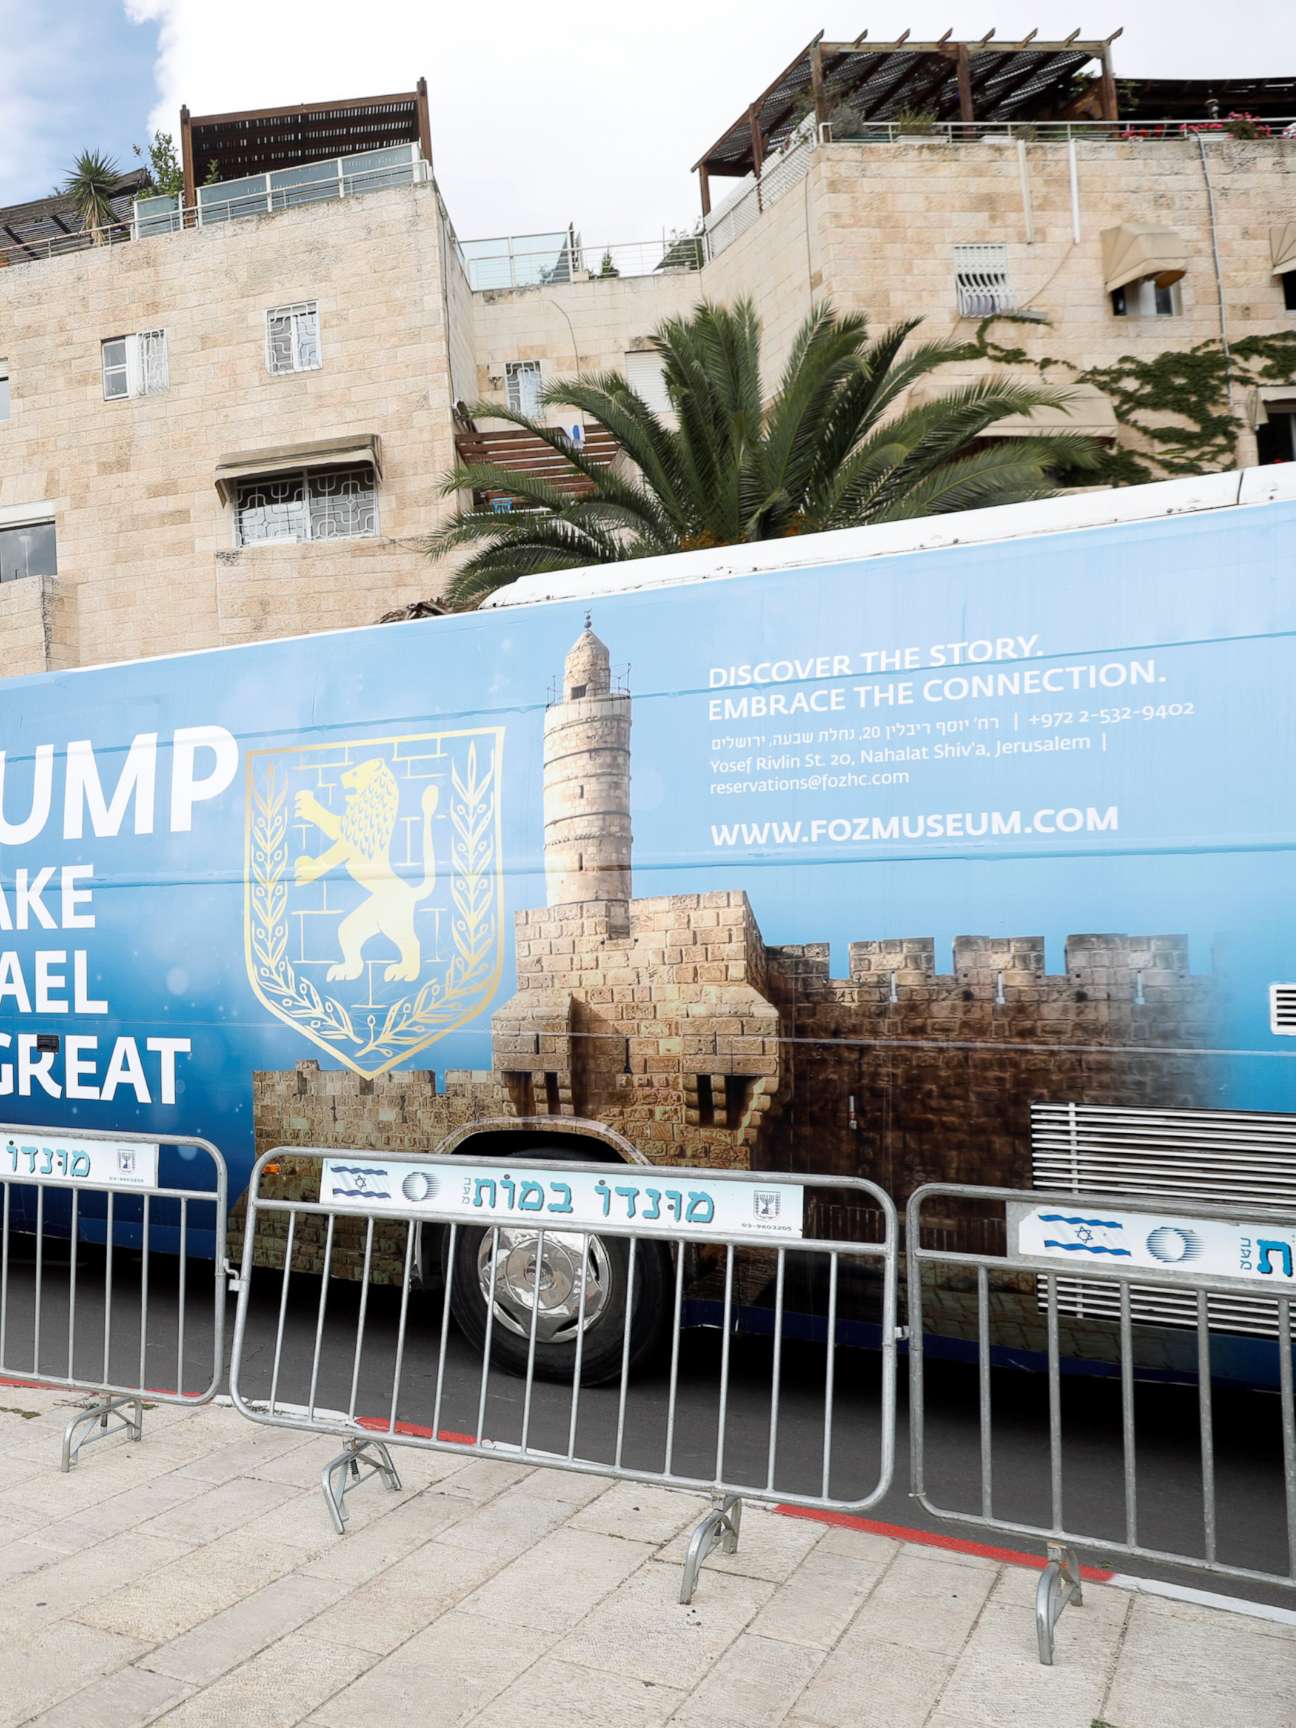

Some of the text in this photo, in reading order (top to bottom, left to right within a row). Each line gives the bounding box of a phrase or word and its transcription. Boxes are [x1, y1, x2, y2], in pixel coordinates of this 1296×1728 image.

[709, 633, 1044, 688] DISCOVER THE STORY.
[708, 659, 1167, 721] EMBRACE THE CONNECTION.
[1028, 711, 1074, 728] +972
[1079, 702, 1196, 724] 2-532-9402
[817, 728, 856, 743] נחלת
[885, 722, 931, 740] ריבלין
[935, 719, 970, 737] יוסף
[711, 735, 766, 750] ירושלים
[710, 757, 753, 774] Yosef
[756, 755, 801, 771] Rivlin
[860, 746, 930, 764] Nahalat
[994, 735, 1091, 758] Jerusalem
[710, 771, 910, 795] reservations@fozhc.com
[710, 805, 1119, 847] WWW.FOZMUSEUM.COM
